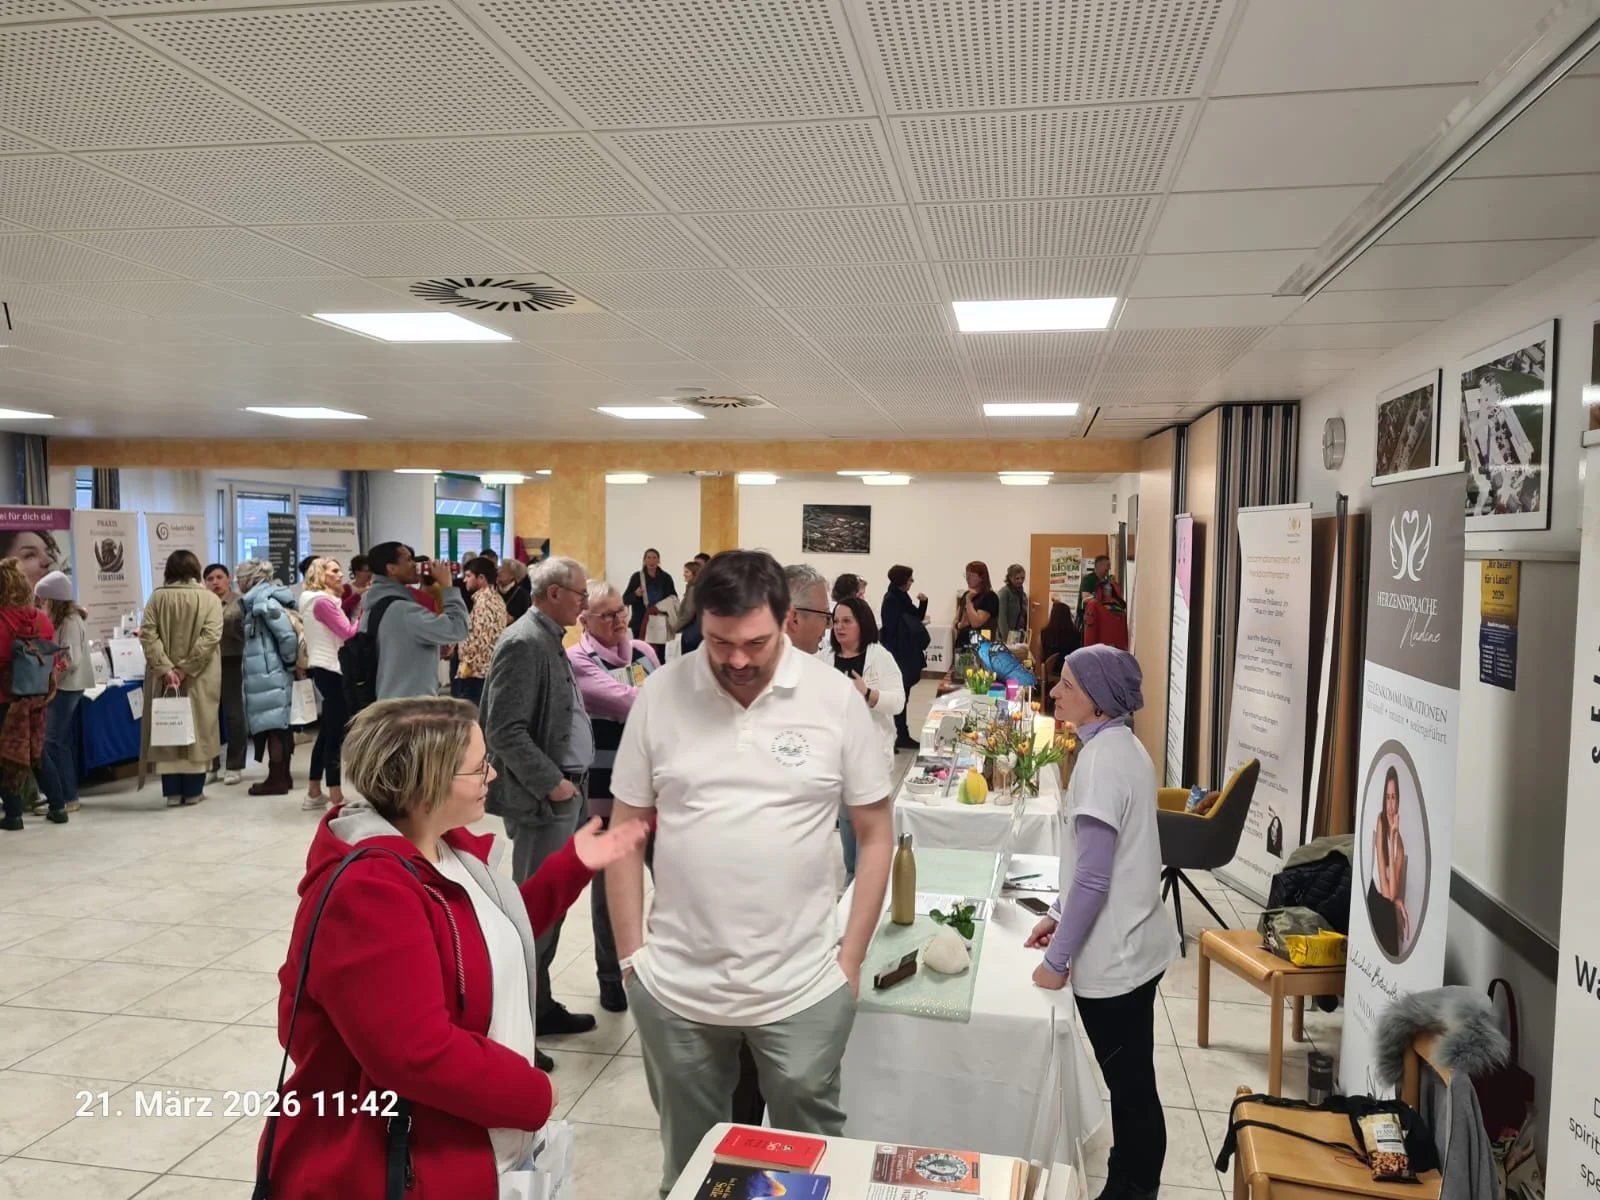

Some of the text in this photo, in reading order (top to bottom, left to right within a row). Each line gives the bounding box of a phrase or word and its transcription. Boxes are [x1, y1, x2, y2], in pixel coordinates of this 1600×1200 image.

[22, 511, 39, 521] dich
[1377, 591, 1438, 616] HERZENSSPRACHE
[1400, 613, 1441, 649] Nadine
[1575, 954, 1600, 1000] W
